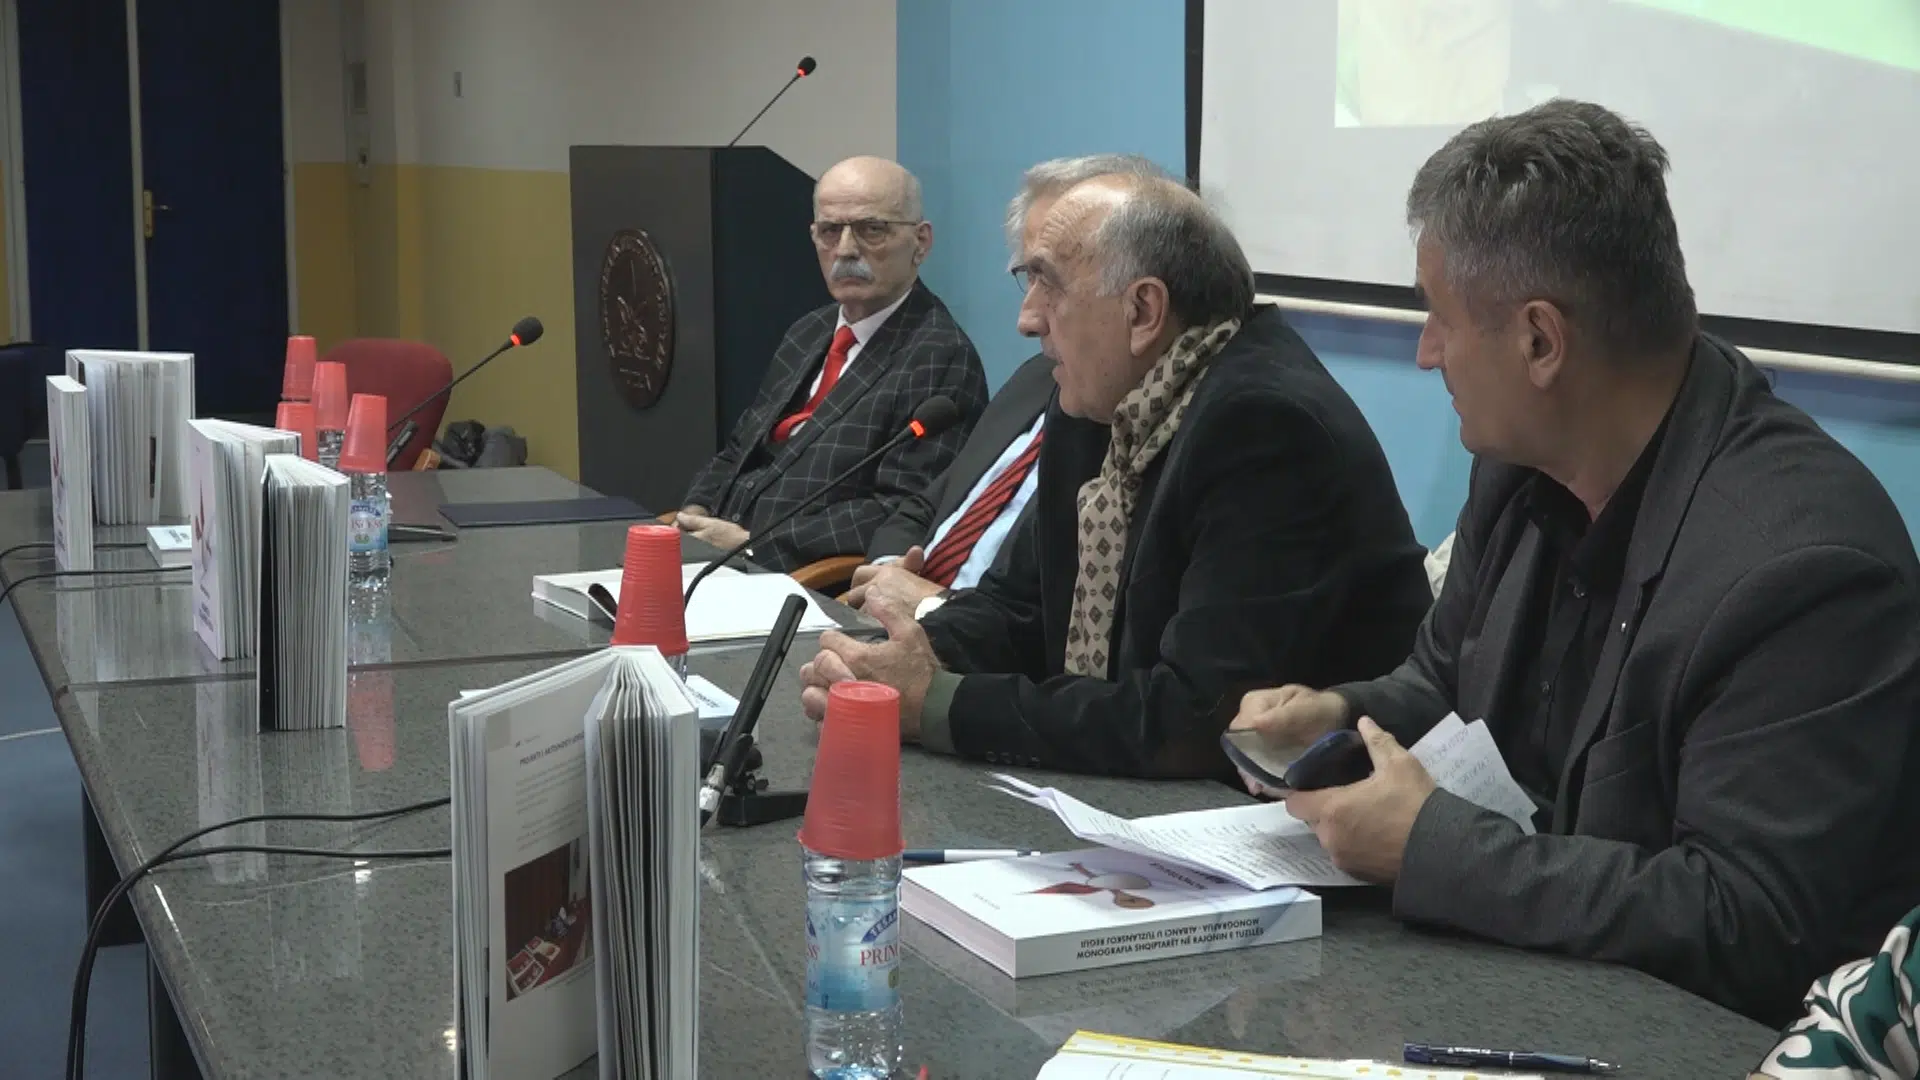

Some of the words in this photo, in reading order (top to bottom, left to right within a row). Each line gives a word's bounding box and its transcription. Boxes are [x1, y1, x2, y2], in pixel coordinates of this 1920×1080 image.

[1157, 928, 1163, 937] U
[1165, 925, 1197, 938] ALBANCI
[1076, 944, 1133, 959] MONOGRAFIA
[1193, 932, 1227, 945] RAJONIN
